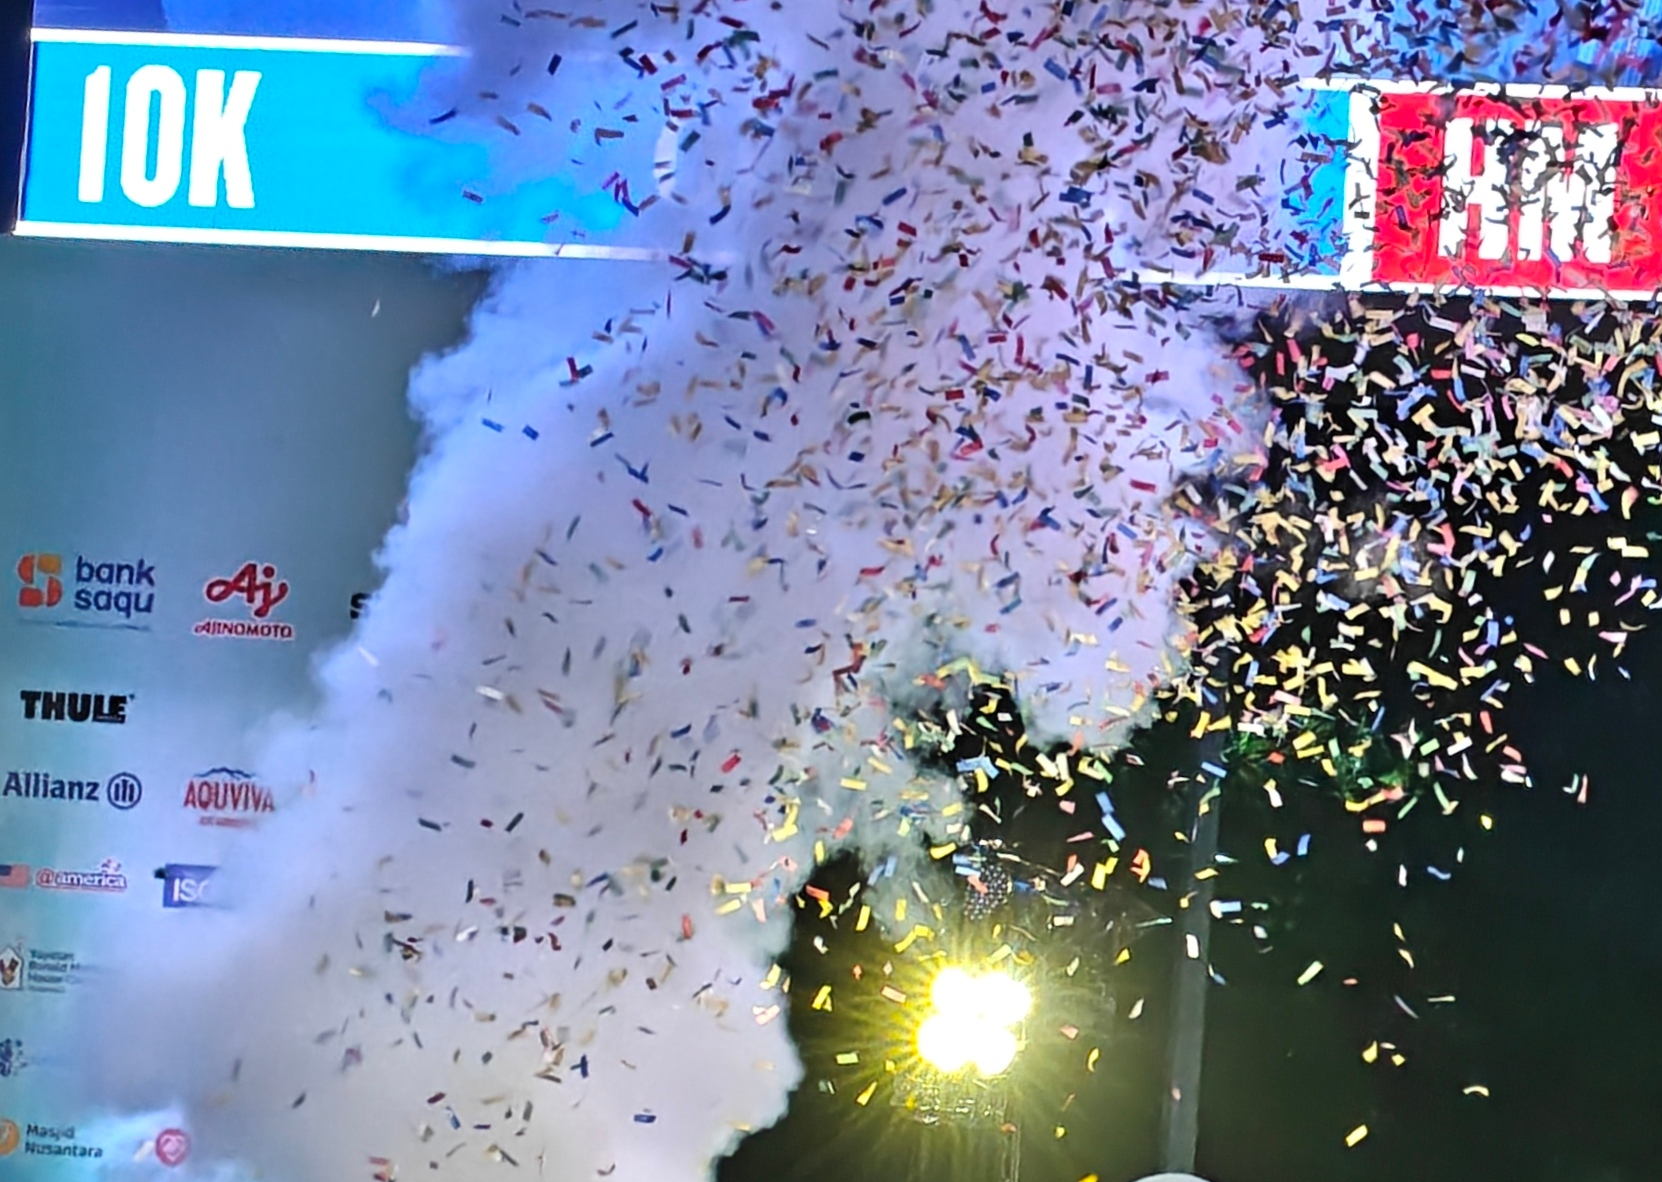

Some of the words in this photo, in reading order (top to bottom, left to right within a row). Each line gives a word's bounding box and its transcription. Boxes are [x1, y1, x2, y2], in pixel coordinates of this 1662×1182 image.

[78, 64, 262, 209] 10K
[75, 555, 156, 587] bank
[74, 587, 155, 619] saqu
[194, 619, 293, 639] AJINOMOTO
[20, 690, 128, 724] THULE
[2, 771, 100, 801] Allianz
[183, 780, 276, 813] AQUVIVA
[26, 1123, 76, 1142] Masjid
[25, 1141, 104, 1158] Nusantara
